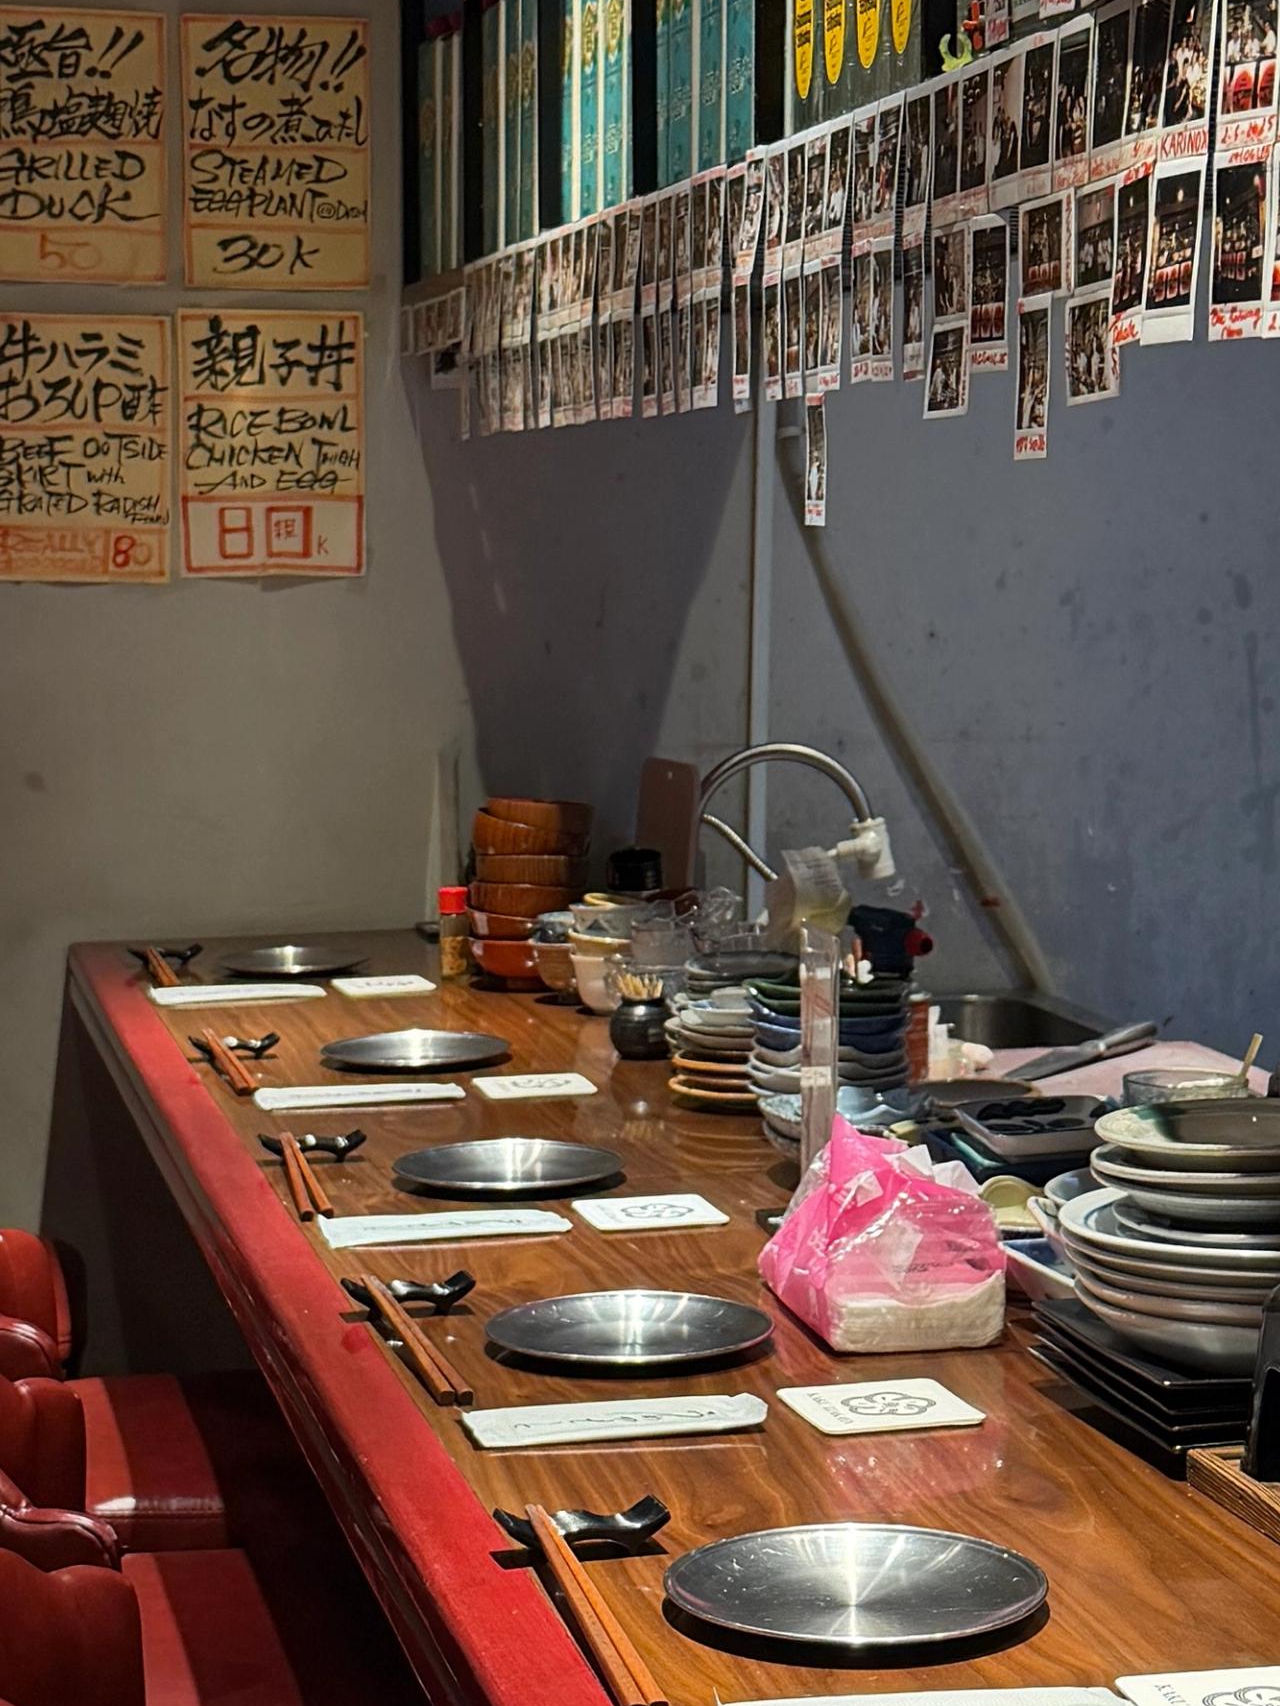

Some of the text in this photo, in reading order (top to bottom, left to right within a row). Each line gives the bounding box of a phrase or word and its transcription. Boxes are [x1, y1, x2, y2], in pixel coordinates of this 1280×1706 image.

[189, 149, 347, 186] STEAMED
[190, 185, 325, 219] EGGPLANT
[193, 314, 357, 391] 親子丼
[189, 402, 357, 439] RICE BOWL
[187, 430, 305, 470] CHICKEN
[85, 465, 126, 485] with
[194, 469, 353, 495] AND EGG
